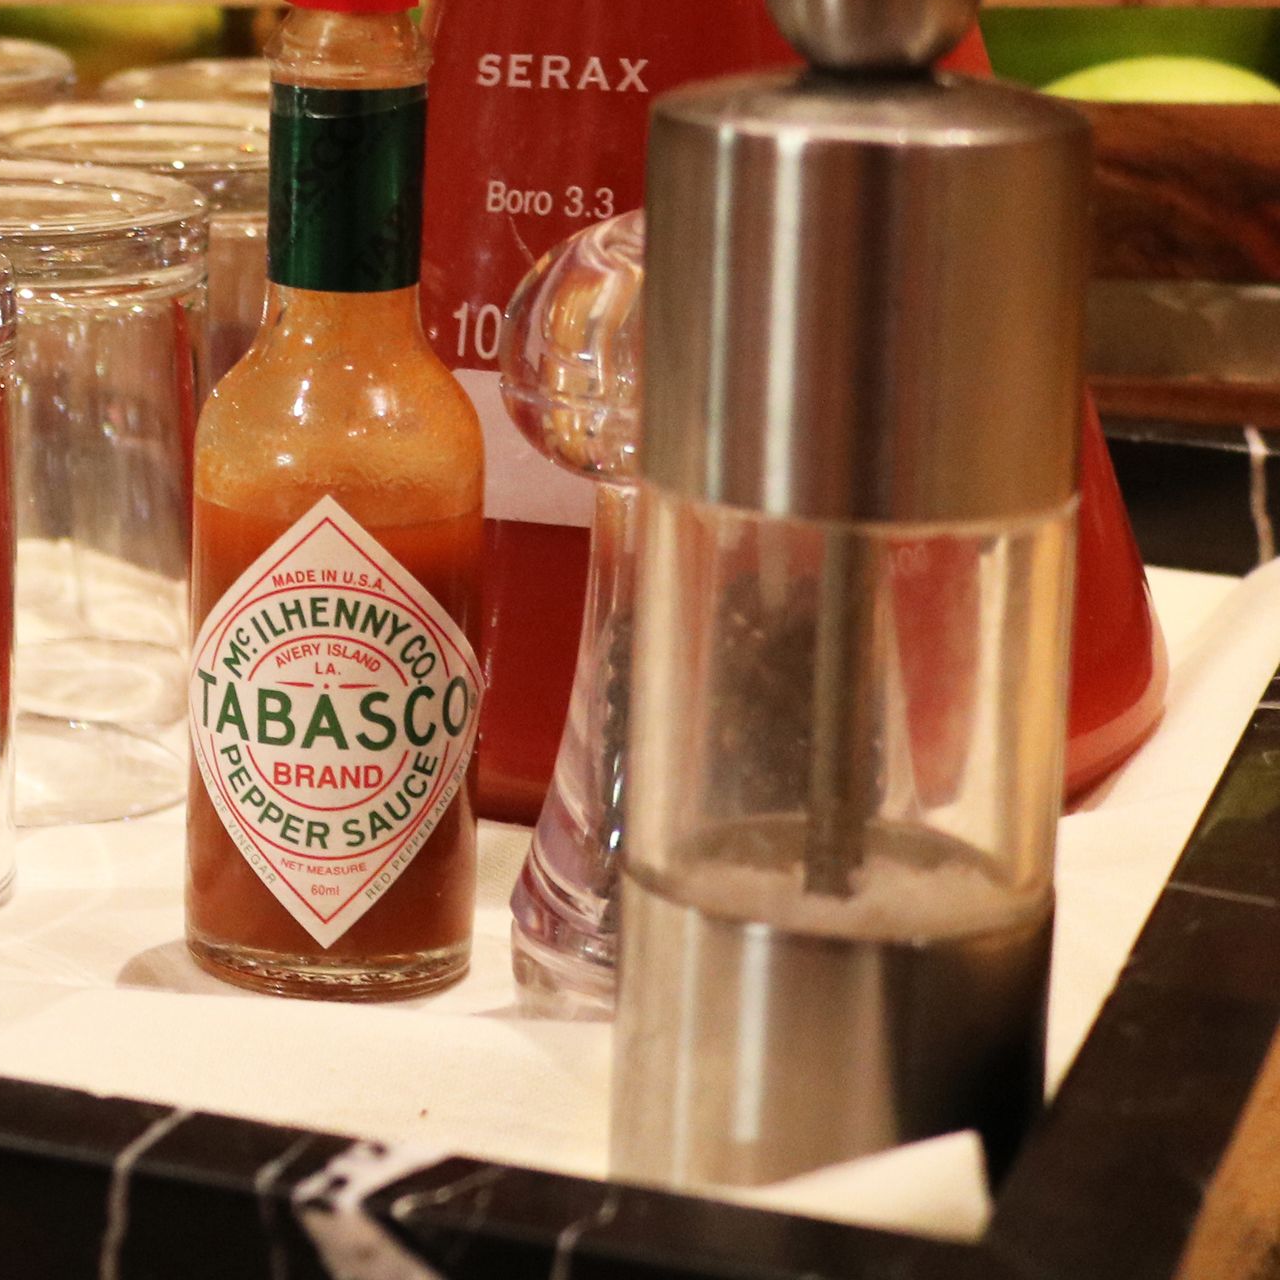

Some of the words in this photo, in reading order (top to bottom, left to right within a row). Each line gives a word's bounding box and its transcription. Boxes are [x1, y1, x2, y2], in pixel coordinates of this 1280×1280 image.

[476, 53, 649, 93] SERAX
[486, 180, 553, 216] Boro
[563, 184, 615, 219] 3.3
[271, 570, 316, 588] MADE
[321, 570, 337, 583] IN
[343, 571, 386, 592] U.S.A.
[275, 643, 321, 668] AVERY
[327, 643, 381, 672] ISLAND
[197, 668, 469, 751] TABASCO
[274, 761, 384, 790] BRAND
[220, 744, 331, 850] PEPPER
[342, 751, 439, 847] SAUCE
[228, 820, 277, 885] VINEGAR
[365, 872, 391, 900] RED
[392, 819, 434, 871] PEPPER
[434, 785, 454, 817] AND
[280, 858, 304, 872] NET
[306, 862, 367, 876] MEASURE
[311, 883, 340, 896] 60ml
